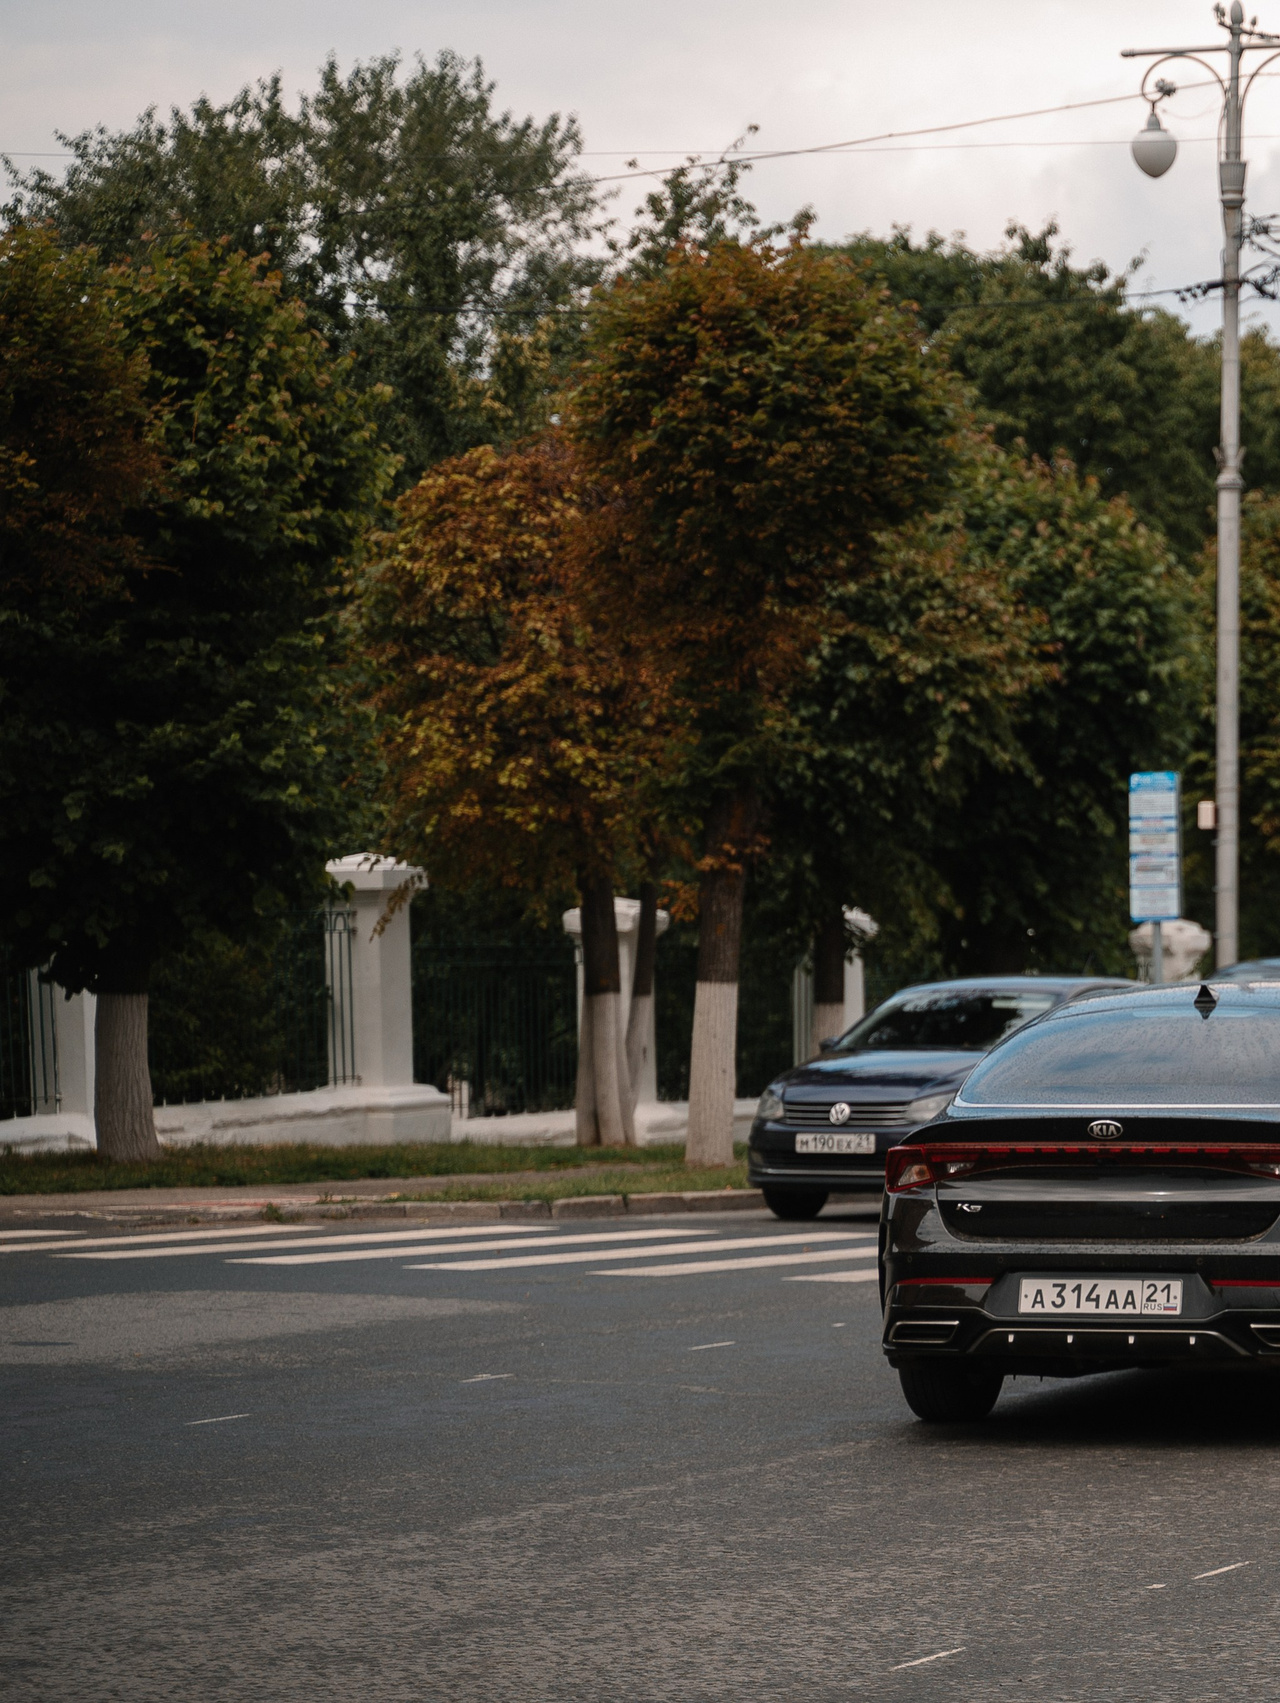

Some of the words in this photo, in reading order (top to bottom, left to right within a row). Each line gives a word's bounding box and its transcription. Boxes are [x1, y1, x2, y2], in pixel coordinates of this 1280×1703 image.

[1092, 1124, 1118, 1136] KIA
[1145, 1283, 1172, 1303] 21
[1143, 1303, 1162, 1311] RUS
